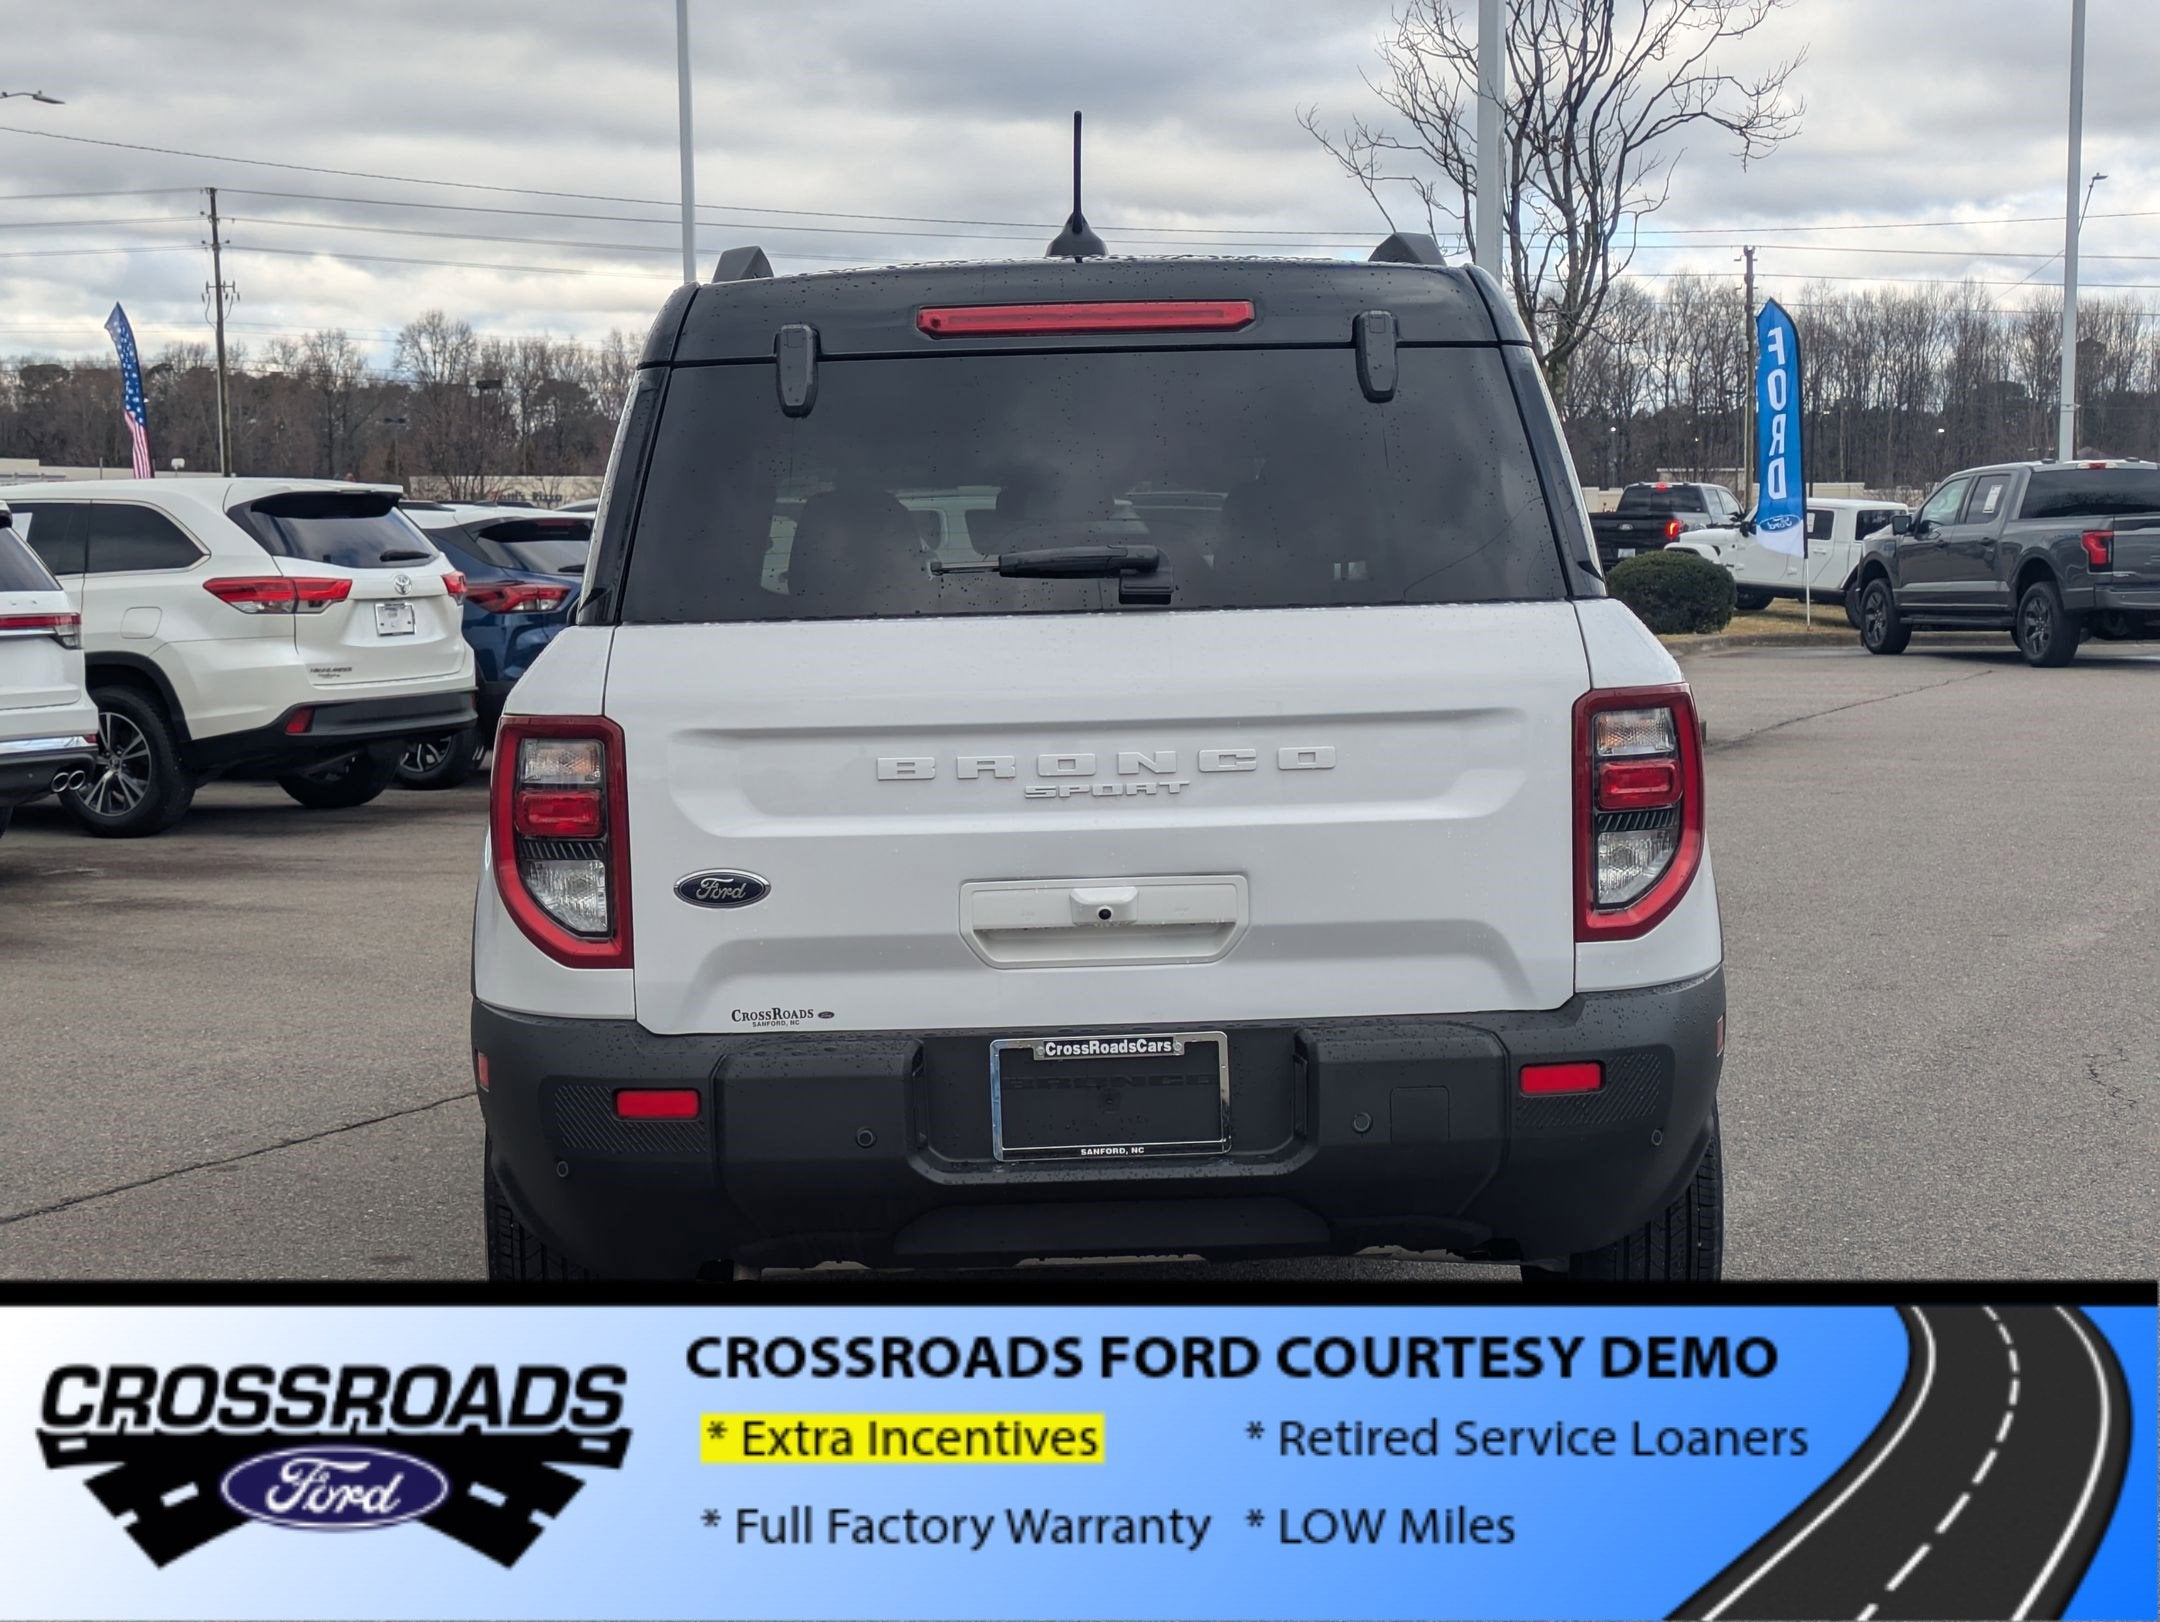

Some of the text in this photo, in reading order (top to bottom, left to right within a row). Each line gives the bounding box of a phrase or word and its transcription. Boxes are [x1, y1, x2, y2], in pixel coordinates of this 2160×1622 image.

[877, 746, 1336, 780] BRONCO
[1024, 780, 1190, 799] SPORT
[696, 877, 747, 900] Ford
[752, 1020, 789, 1028] SANFORD,
[1045, 1037, 1172, 1056] CrossRoadsCars
[1080, 1146, 1145, 1156] SANFORD, NC
